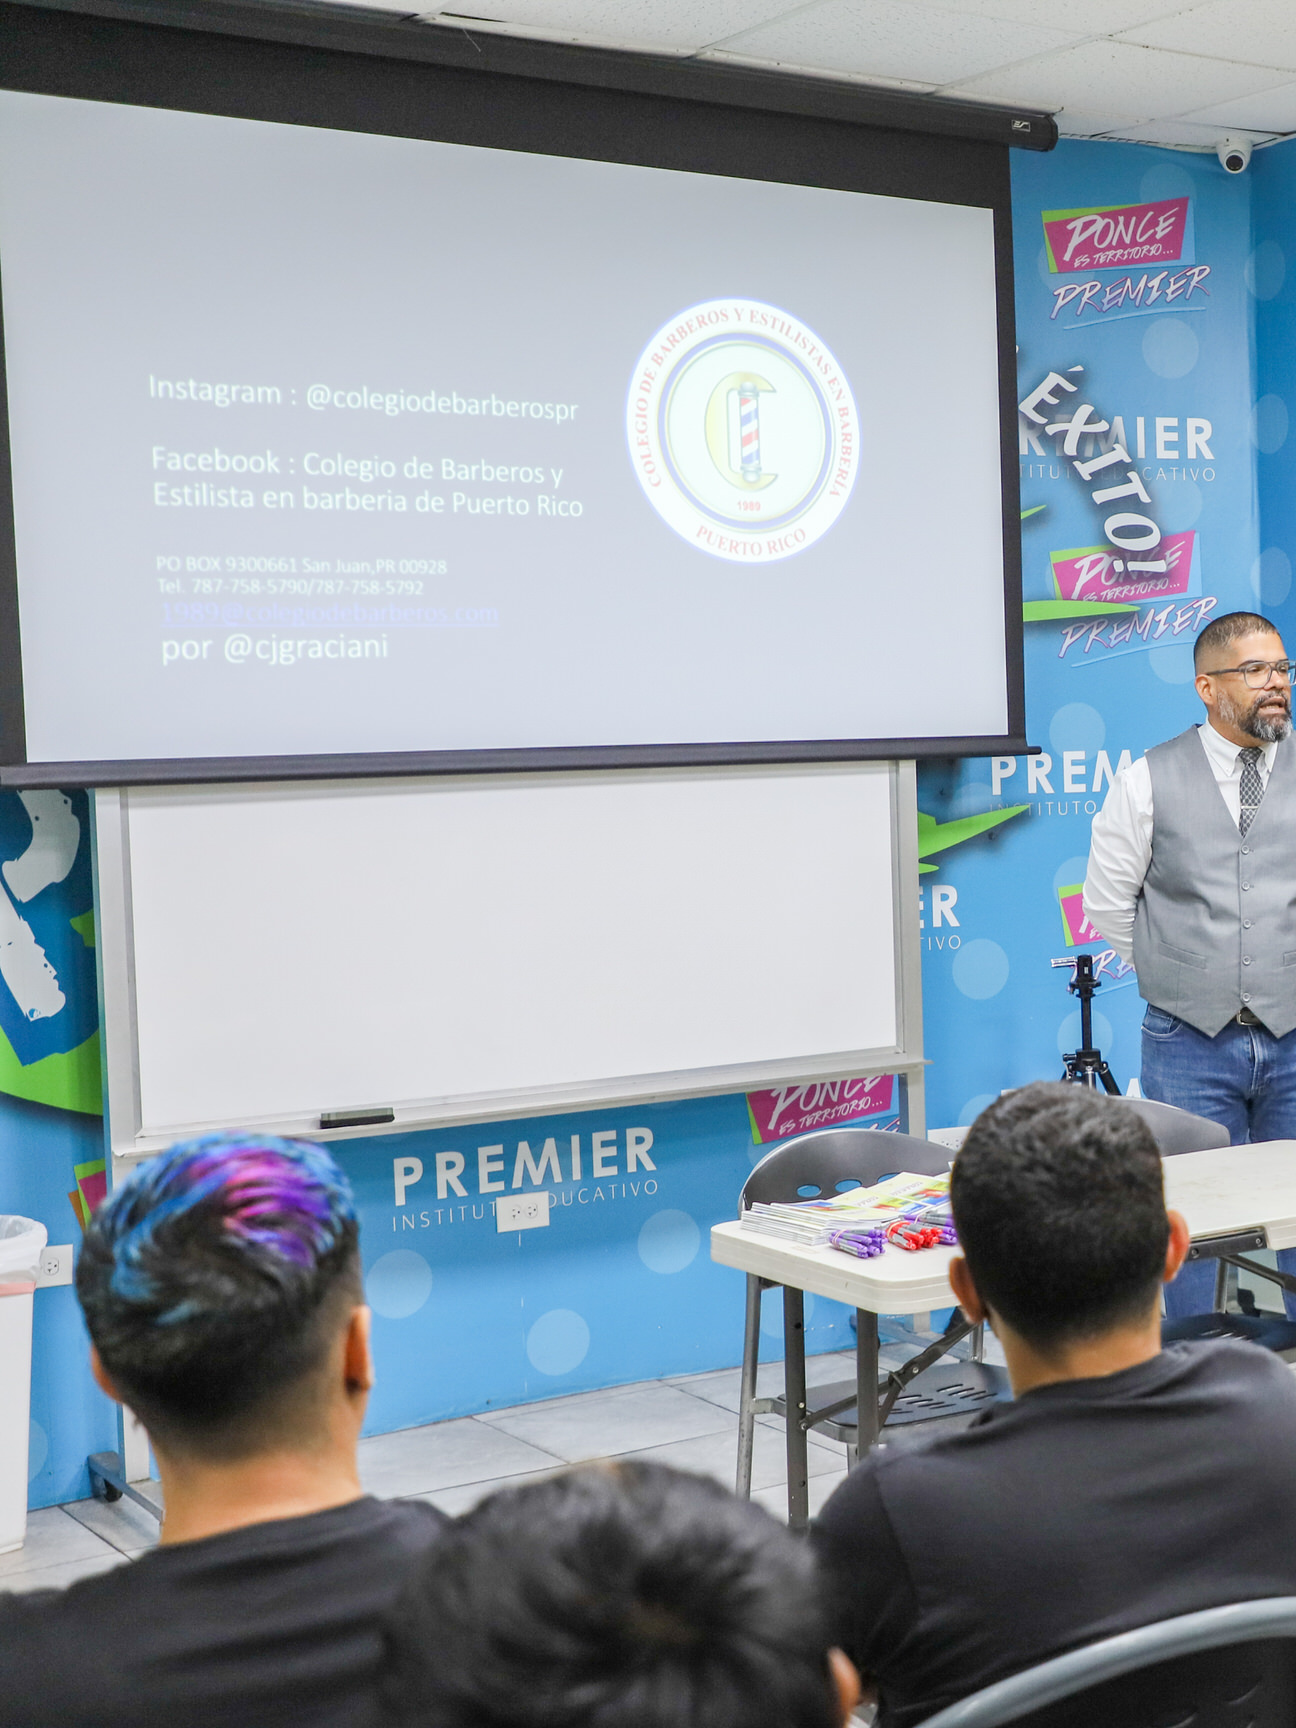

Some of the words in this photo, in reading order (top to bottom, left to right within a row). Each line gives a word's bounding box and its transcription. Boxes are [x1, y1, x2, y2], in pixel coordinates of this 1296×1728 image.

[1063, 207, 1179, 262] PONCE
[1074, 253, 1090, 268] ES
[1093, 243, 1173, 264] TERRITORIO...
[1050, 265, 1211, 320] PREMIER
[734, 308, 745, 322] Y
[651, 308, 729, 367] BARBEROS
[749, 309, 832, 376] ESTILISTAS
[149, 374, 281, 407] Instagram
[306, 384, 580, 424] @colegiodebarberospr
[639, 367, 657, 393] DE
[828, 376, 846, 401] EN
[635, 396, 662, 488] COLEGIO
[152, 446, 280, 475] Facebook
[303, 452, 396, 482] Colegio
[404, 455, 433, 480] de
[441, 458, 545, 484] Barberos
[551, 466, 564, 488] y
[1018, 365, 1168, 573] ÉXITO!
[153, 482, 255, 508] Estilista
[263, 488, 294, 509] en
[303, 485, 407, 512] barberia
[415, 489, 445, 513] de
[452, 491, 530, 516] Puerto
[537, 493, 584, 518] Rico
[696, 525, 763, 556] PUERTO
[768, 528, 806, 555] RICO
[156, 556, 181, 573] PO
[185, 556, 222, 573] BOX
[225, 556, 298, 574] 9300661
[302, 558, 331, 574] San
[399, 559, 448, 575] 00928
[157, 578, 185, 595] Tel.
[1058, 596, 1218, 658] PREMIER
[161, 639, 212, 666] por
[224, 633, 389, 666] @cjgraciani
[991, 749, 1150, 796] PREM
[779, 1120, 796, 1136] ES
[799, 1097, 883, 1129] TERRITORIO...
[393, 1127, 657, 1206] PREMIER
[393, 1201, 497, 1232] INSTITUT
[549, 1179, 658, 1209] DUCATIVO
